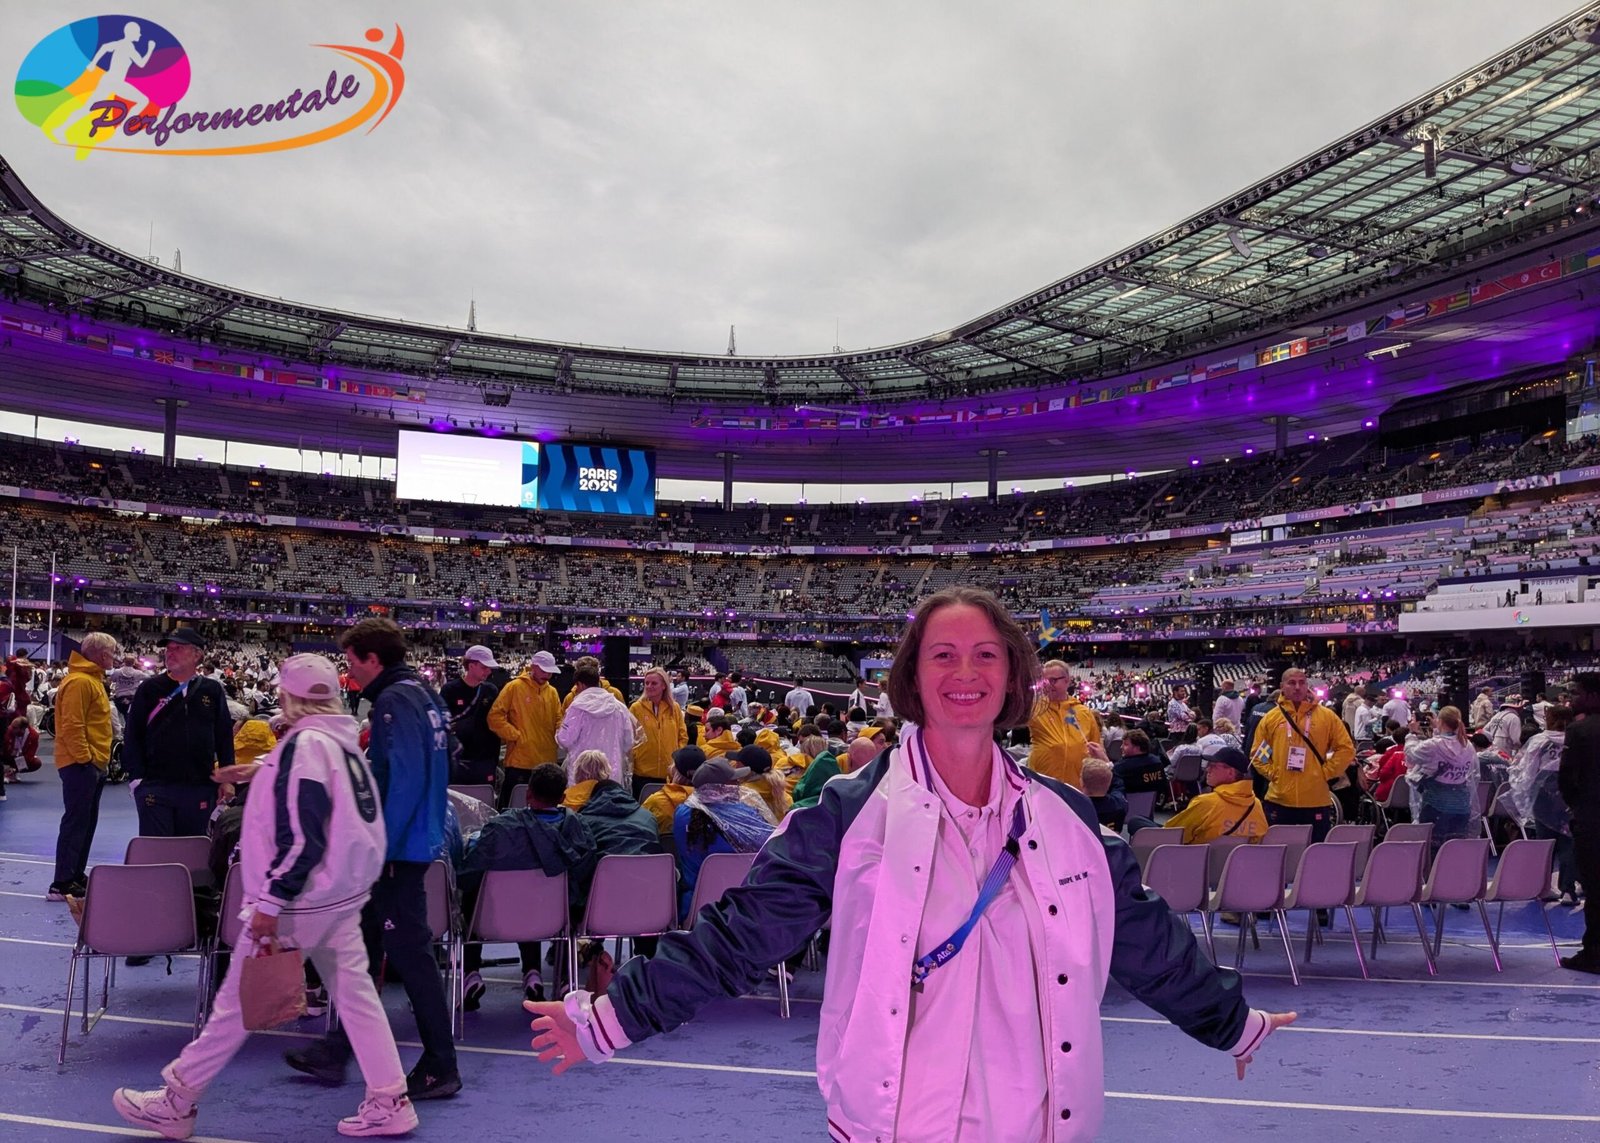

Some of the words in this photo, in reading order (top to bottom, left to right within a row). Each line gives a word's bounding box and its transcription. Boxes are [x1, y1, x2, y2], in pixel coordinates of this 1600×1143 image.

[579, 467, 617, 480] PARIS
[579, 479, 617, 493] 2024
[1435, 490, 1457, 500] PARIS
[1143, 770, 1162, 783] SWE
